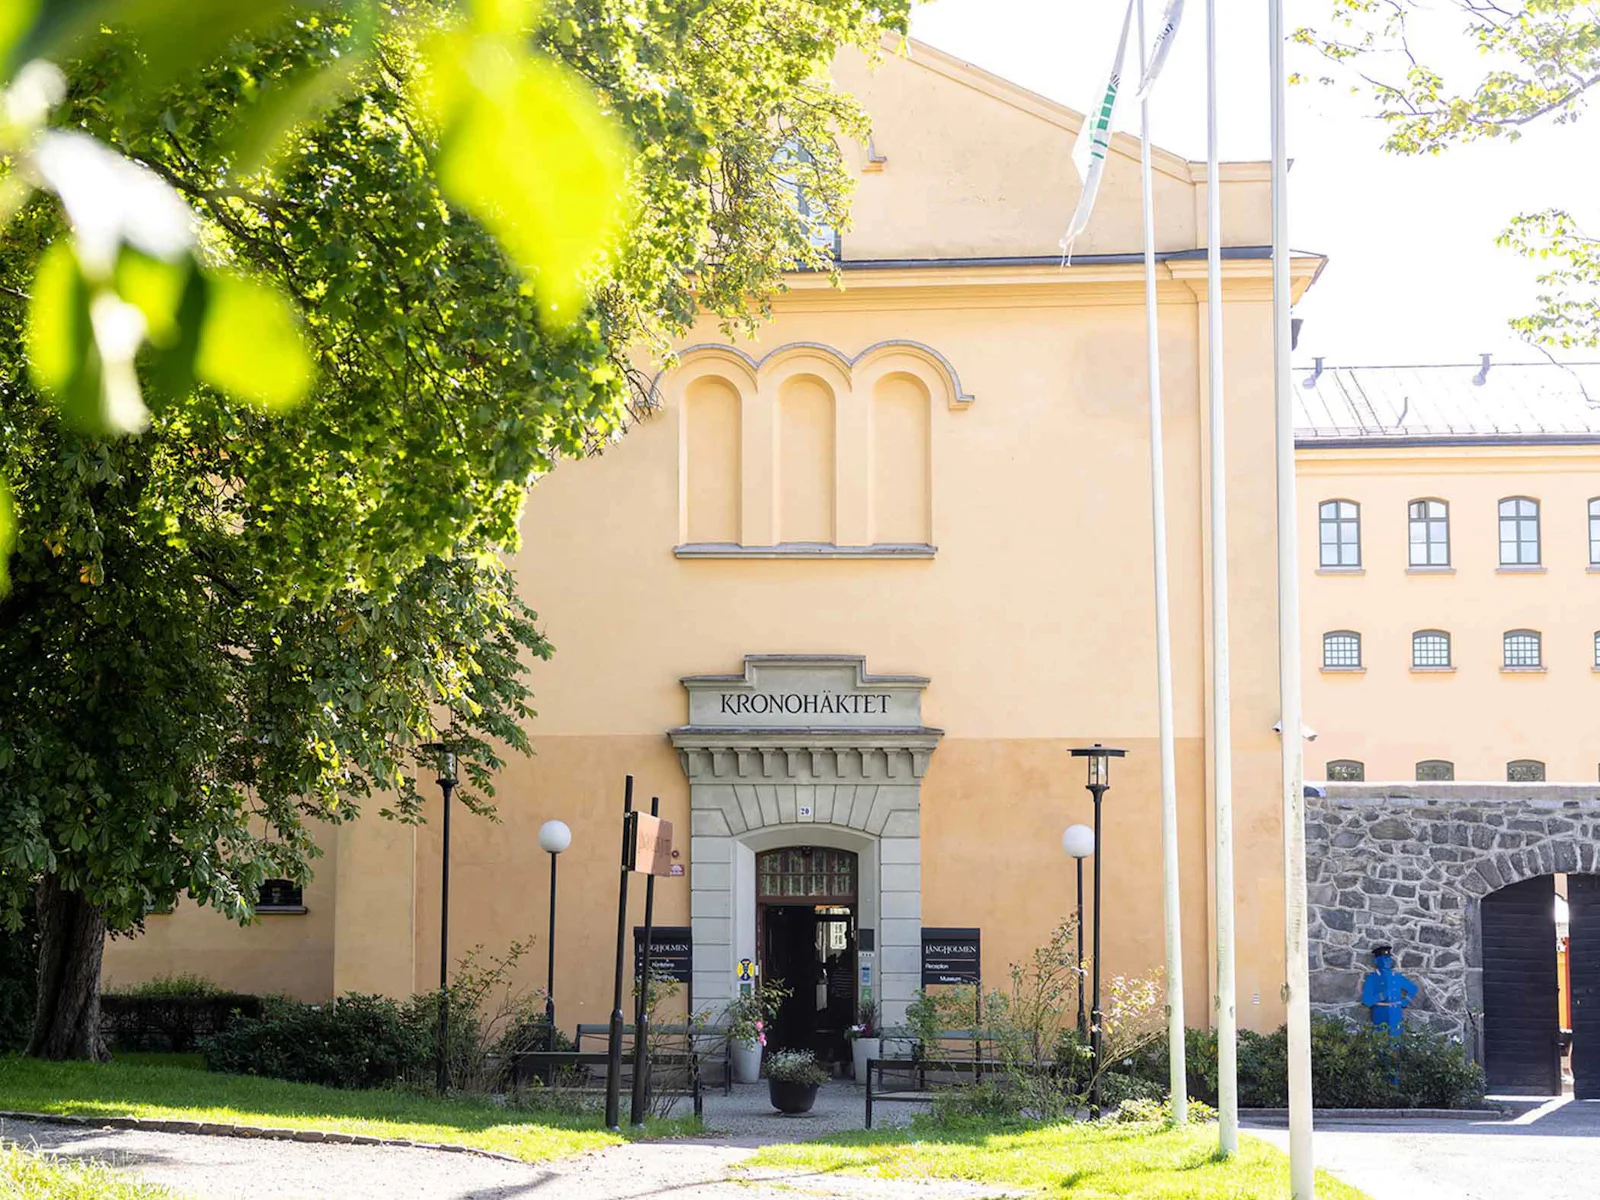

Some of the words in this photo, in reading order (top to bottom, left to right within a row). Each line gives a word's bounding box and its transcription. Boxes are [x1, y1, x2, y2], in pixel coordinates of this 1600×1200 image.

[720, 690, 892, 716] KRONOHÄKTET
[800, 807, 810, 815] 20
[638, 944, 689, 953] LGHOLMEN
[925, 944, 976, 954] LÅNGHOLMEN
